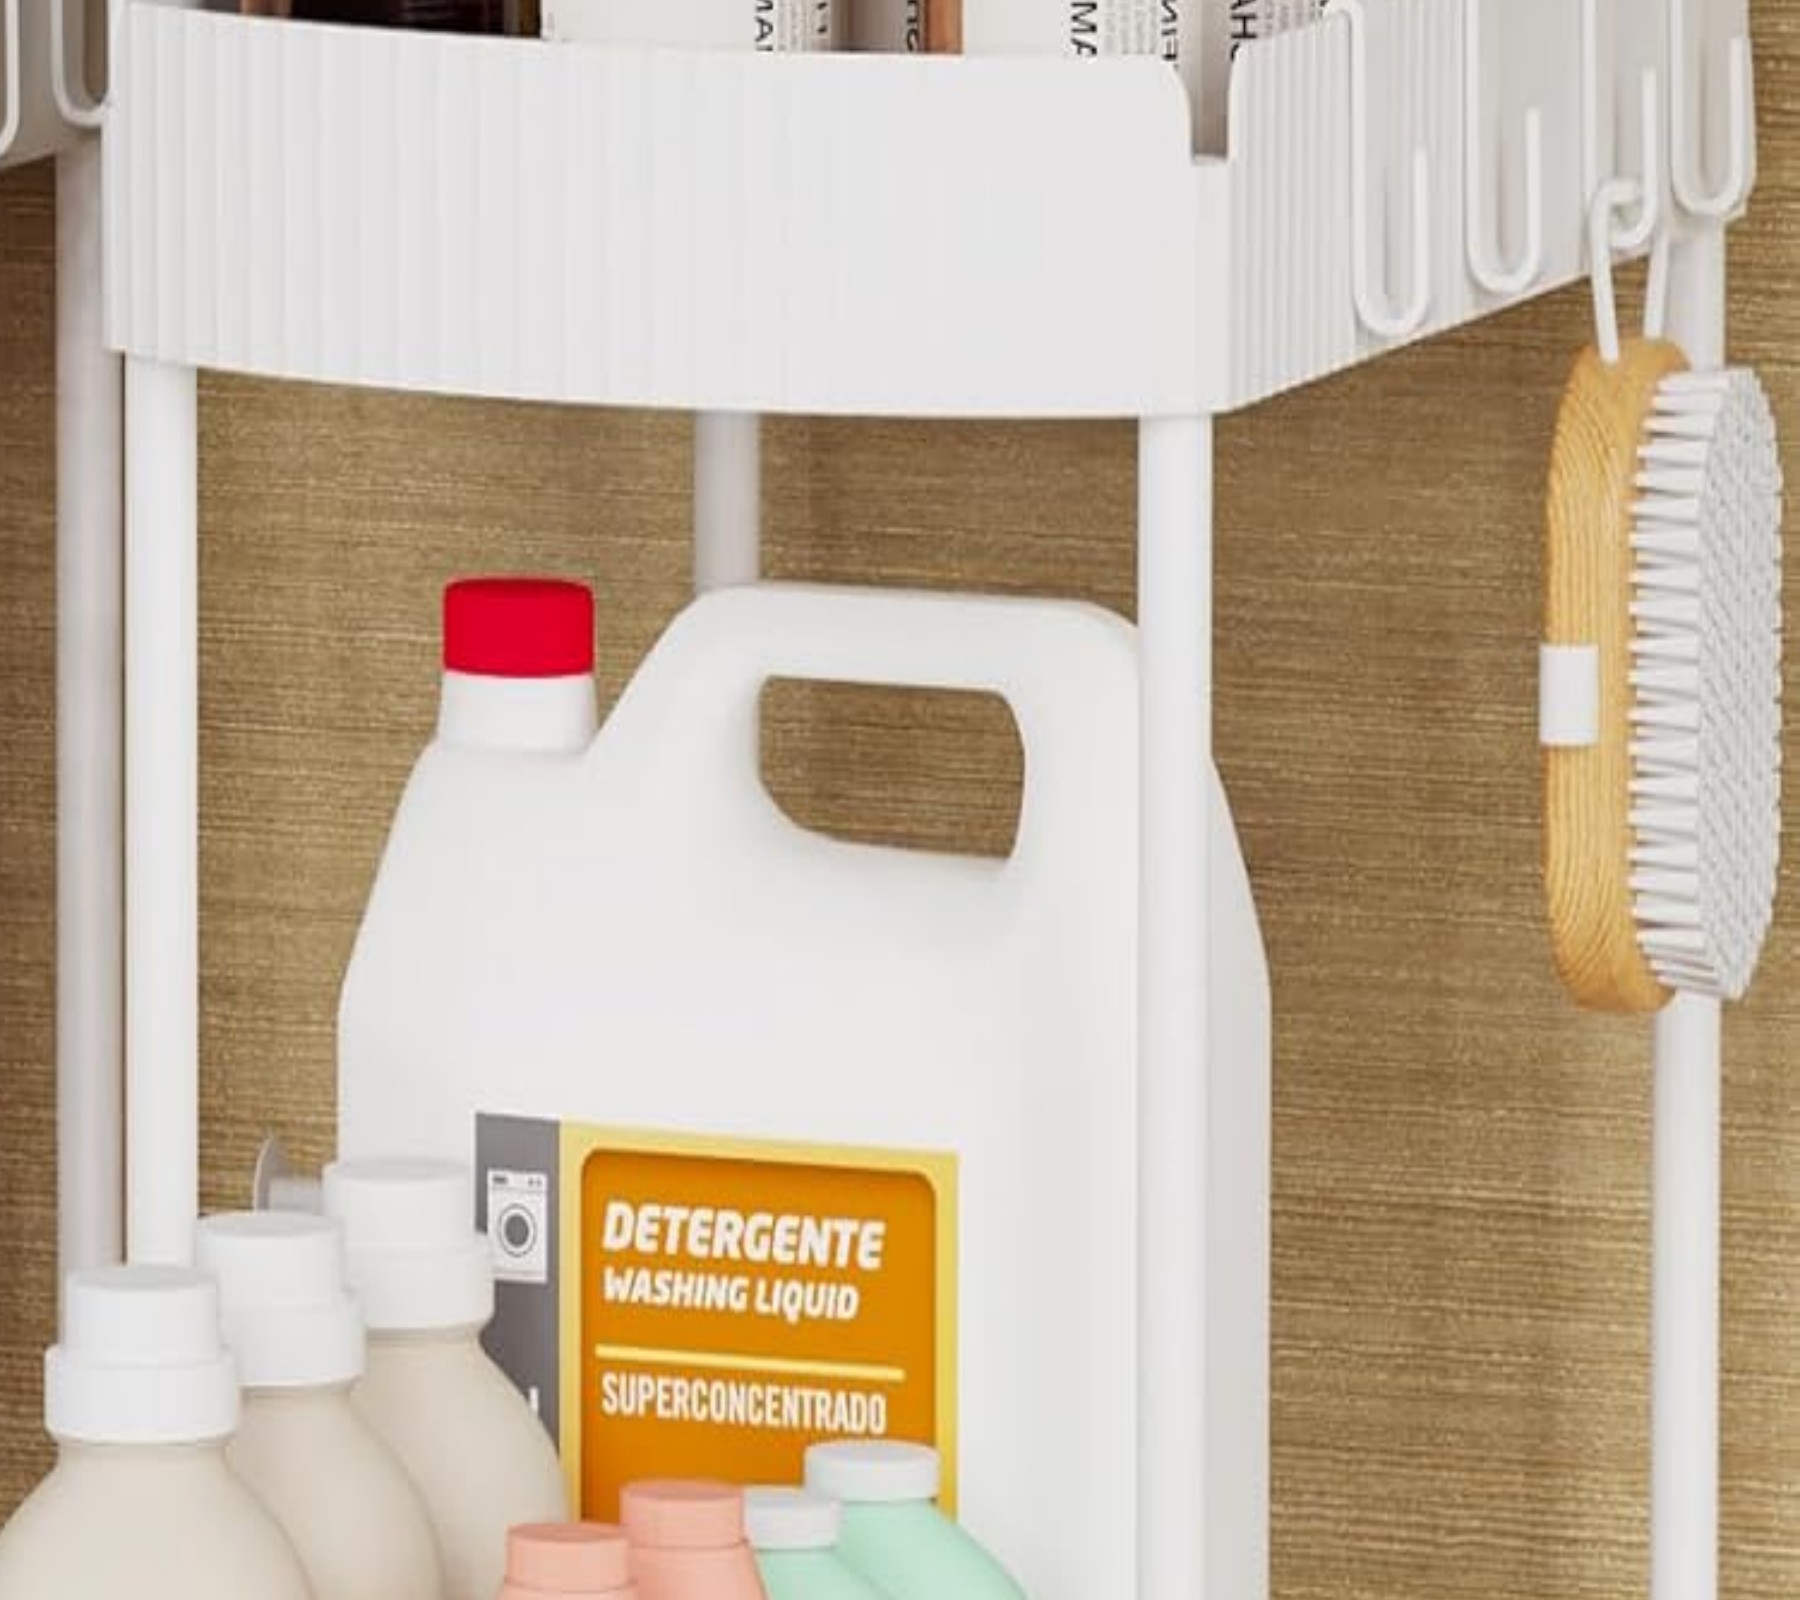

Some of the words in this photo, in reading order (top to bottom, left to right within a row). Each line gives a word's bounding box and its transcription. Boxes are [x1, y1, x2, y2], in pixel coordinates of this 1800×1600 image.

[602, 1200, 887, 1270] DETERGENTE
[604, 1266, 748, 1312] WASHING
[754, 1280, 861, 1324] LIQUID
[602, 1371, 888, 1436] SUPERCONCENTRADO
